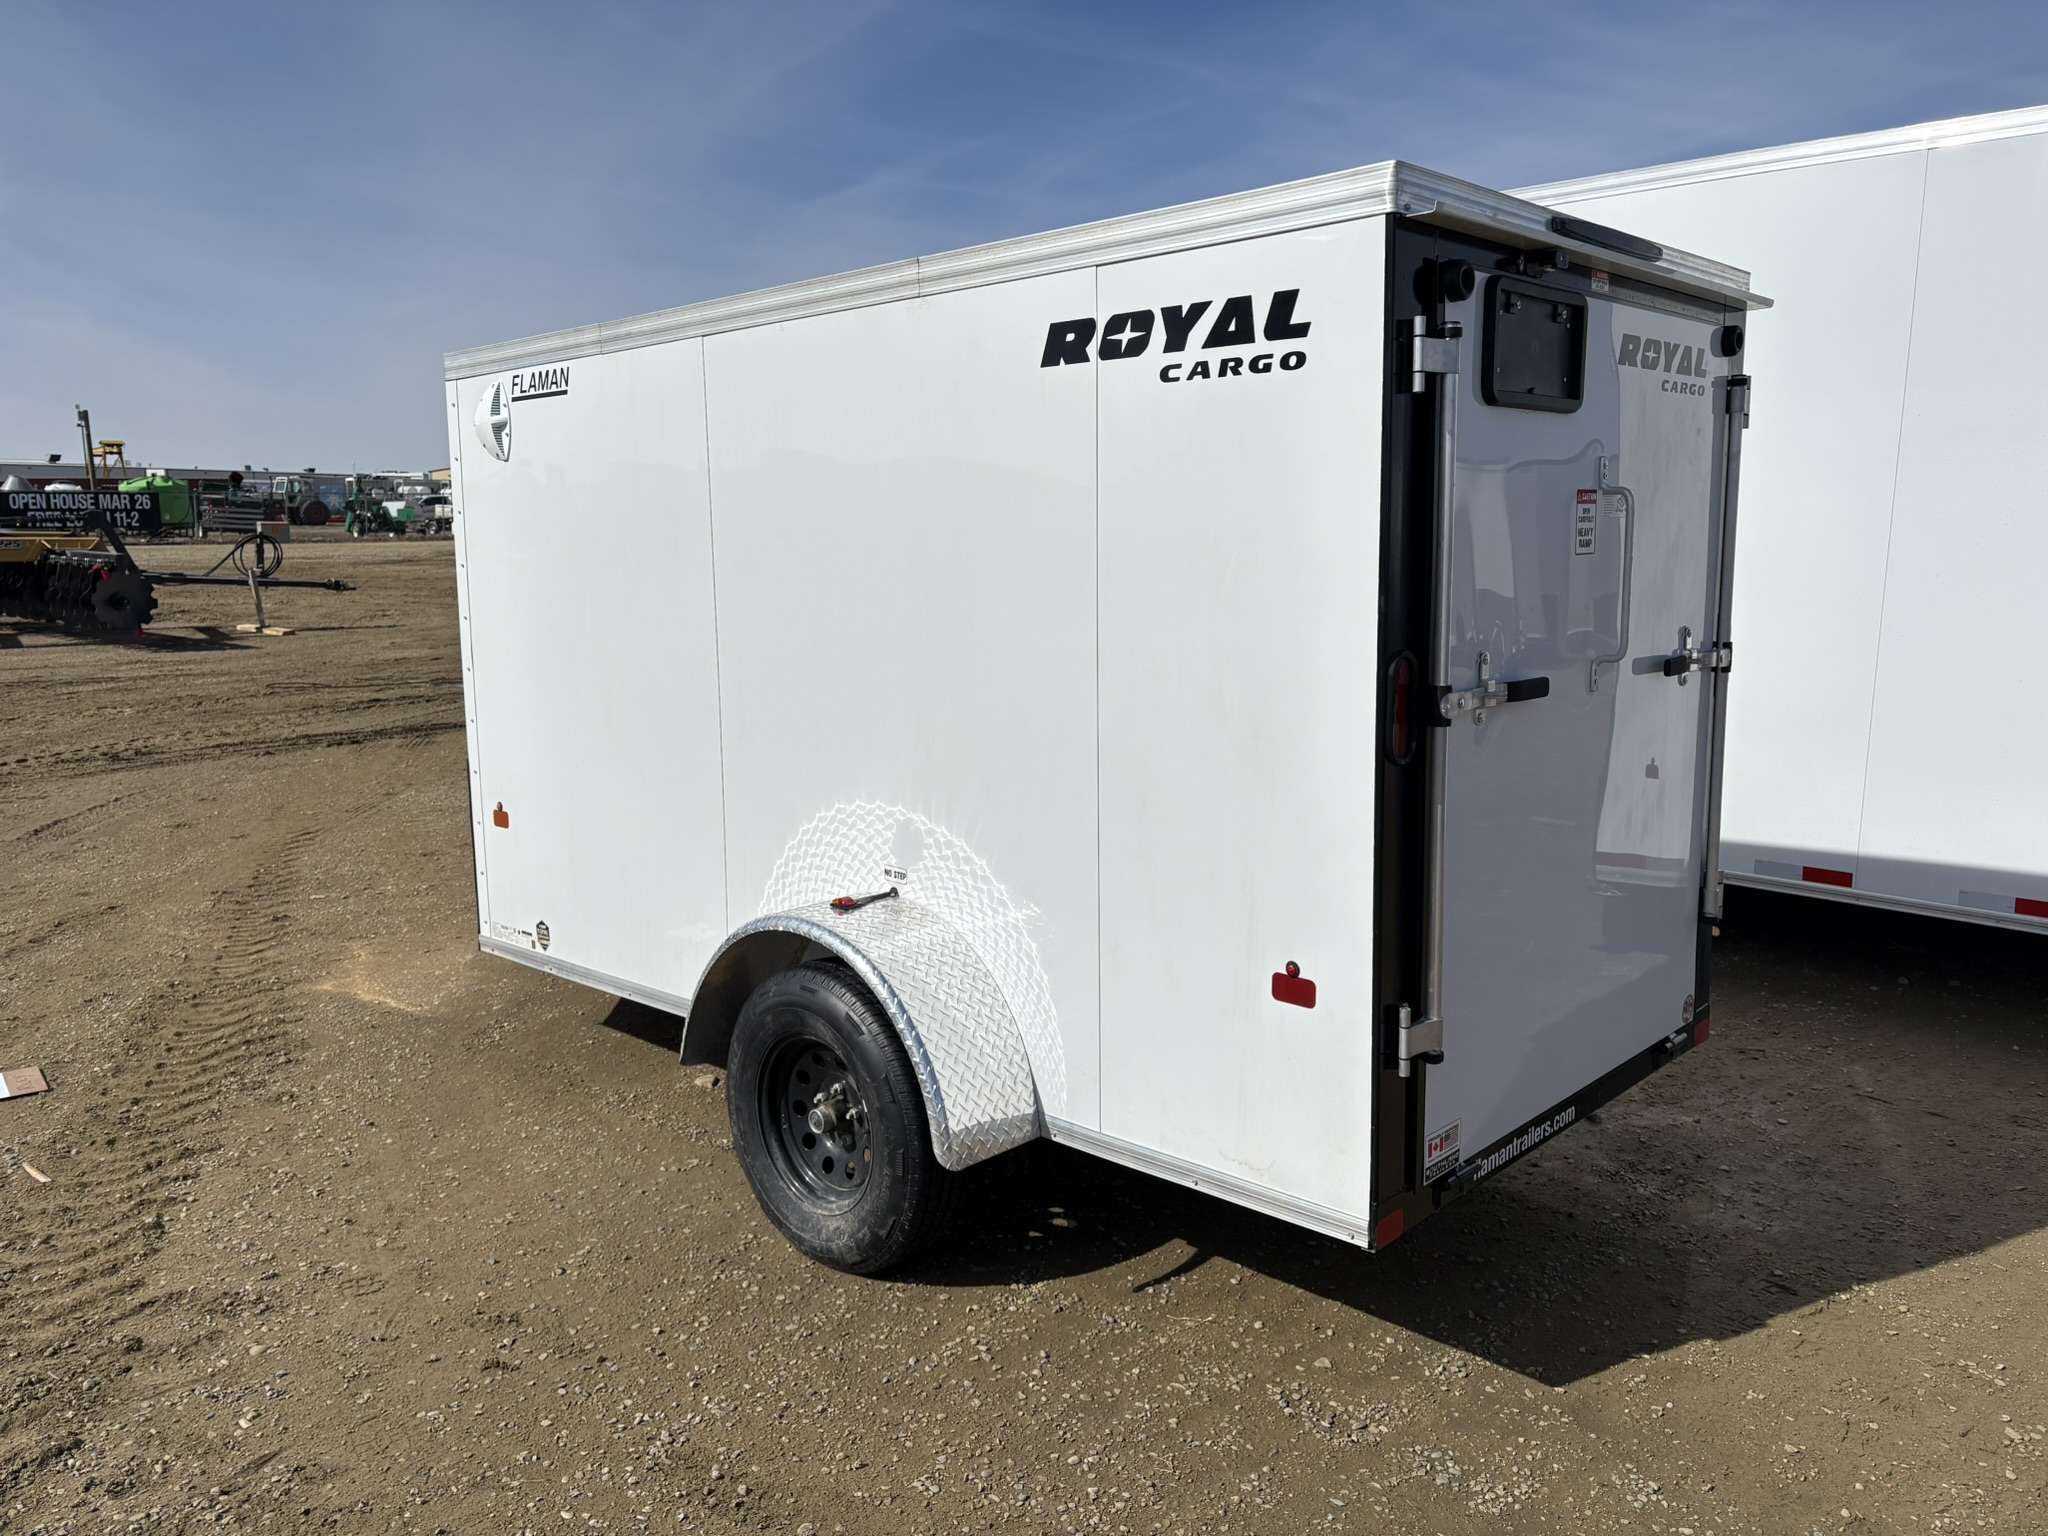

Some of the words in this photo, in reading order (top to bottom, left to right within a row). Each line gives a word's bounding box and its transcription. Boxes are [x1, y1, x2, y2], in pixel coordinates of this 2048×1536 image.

[1040, 288, 1312, 368] ROYAL
[1159, 350, 1307, 383] CARGO
[1617, 333, 1707, 379] ROYAL
[511, 366, 570, 395] FLAMAN
[1661, 380, 1706, 397] CARGO
[8, 493, 46, 509] OPEN
[50, 493, 95, 509] HOUSE
[99, 493, 131, 509] MAR
[134, 494, 151, 510] 26
[113, 511, 140, 527] 11-2
[1578, 527, 1594, 538] HEAVY
[884, 868, 892, 877] NO
[894, 870, 907, 880] STEP
[1473, 1105, 1576, 1182] amantrailers.com
